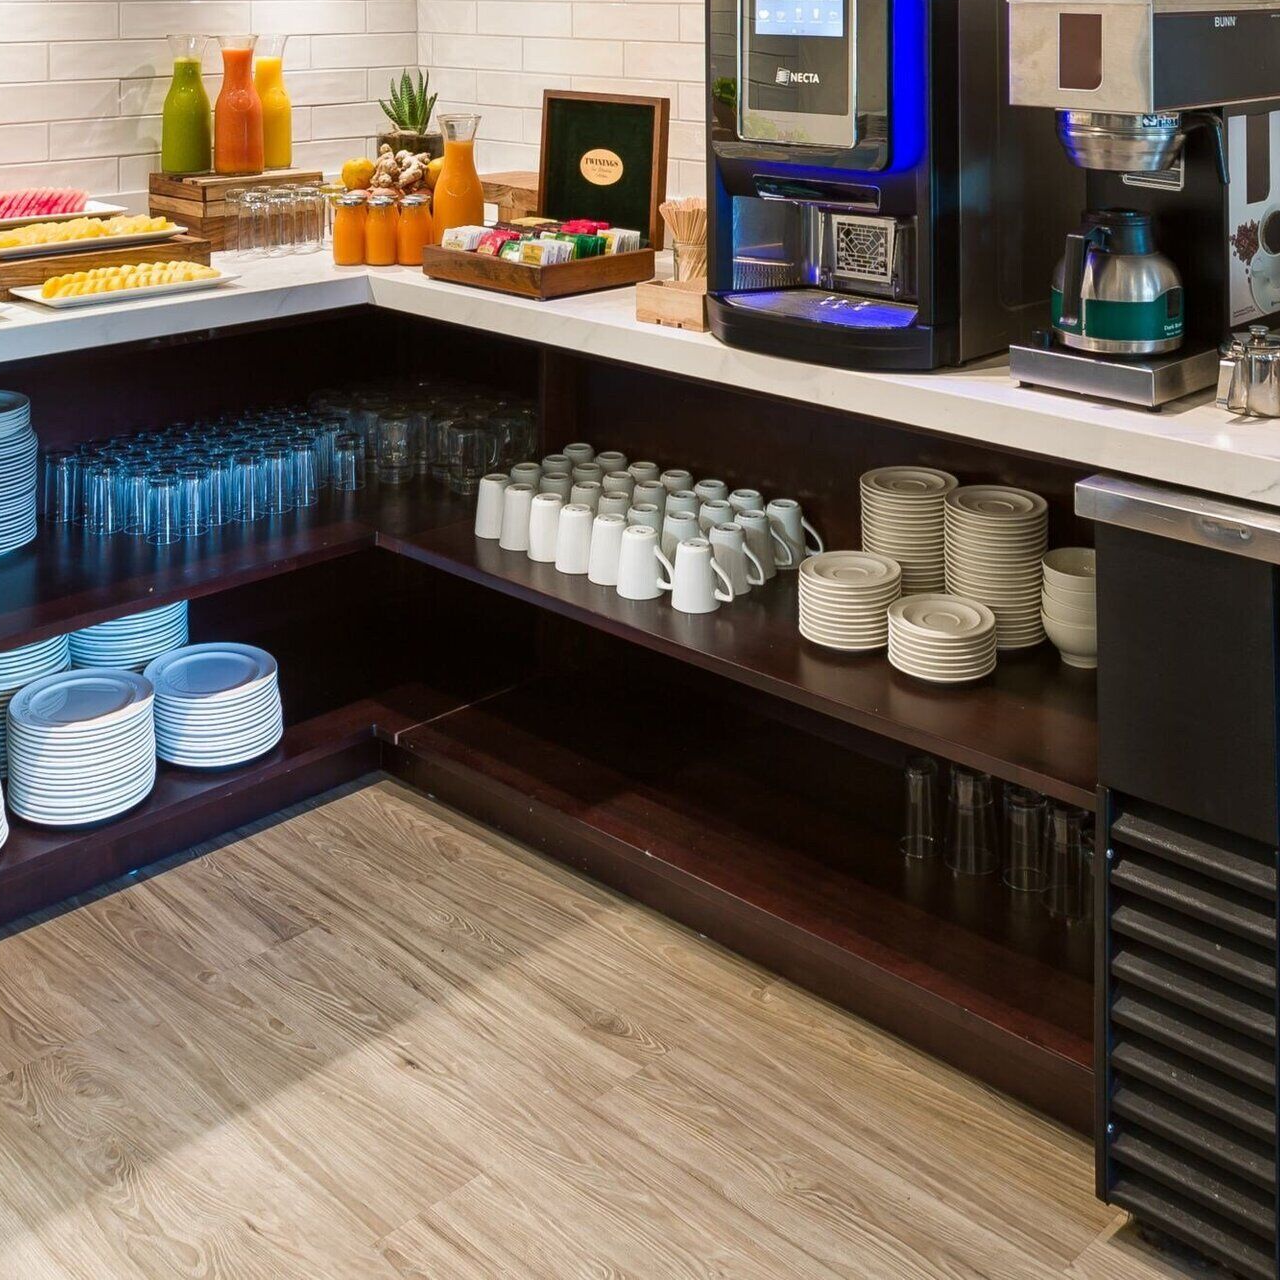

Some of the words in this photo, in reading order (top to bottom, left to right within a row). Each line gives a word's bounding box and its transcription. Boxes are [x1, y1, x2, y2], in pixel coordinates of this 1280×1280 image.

[1214, 16, 1236, 28] BUNN
[790, 72, 820, 84] NECTA
[585, 157, 619, 168] TWININGS
